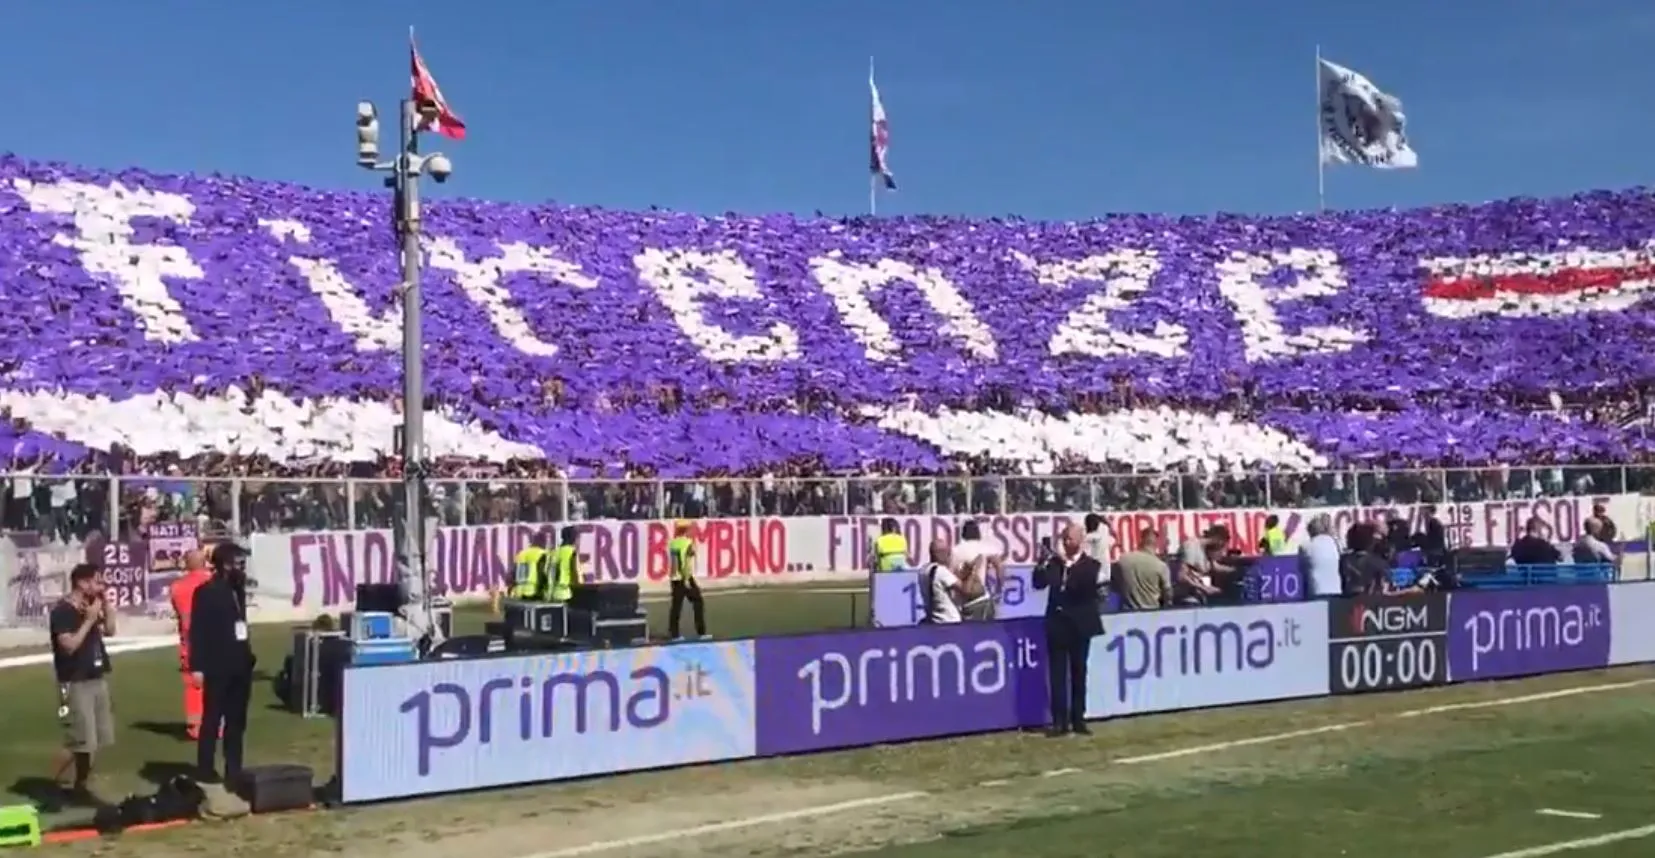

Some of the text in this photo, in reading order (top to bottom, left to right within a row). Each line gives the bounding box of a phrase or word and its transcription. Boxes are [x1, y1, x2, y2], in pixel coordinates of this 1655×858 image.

[1105, 617, 1302, 703] prima.it
[1341, 639, 1436, 689] 00:00
[1464, 604, 1601, 672] prima.it
[400, 661, 713, 776] prima.it
[797, 638, 1039, 735] prima.it
